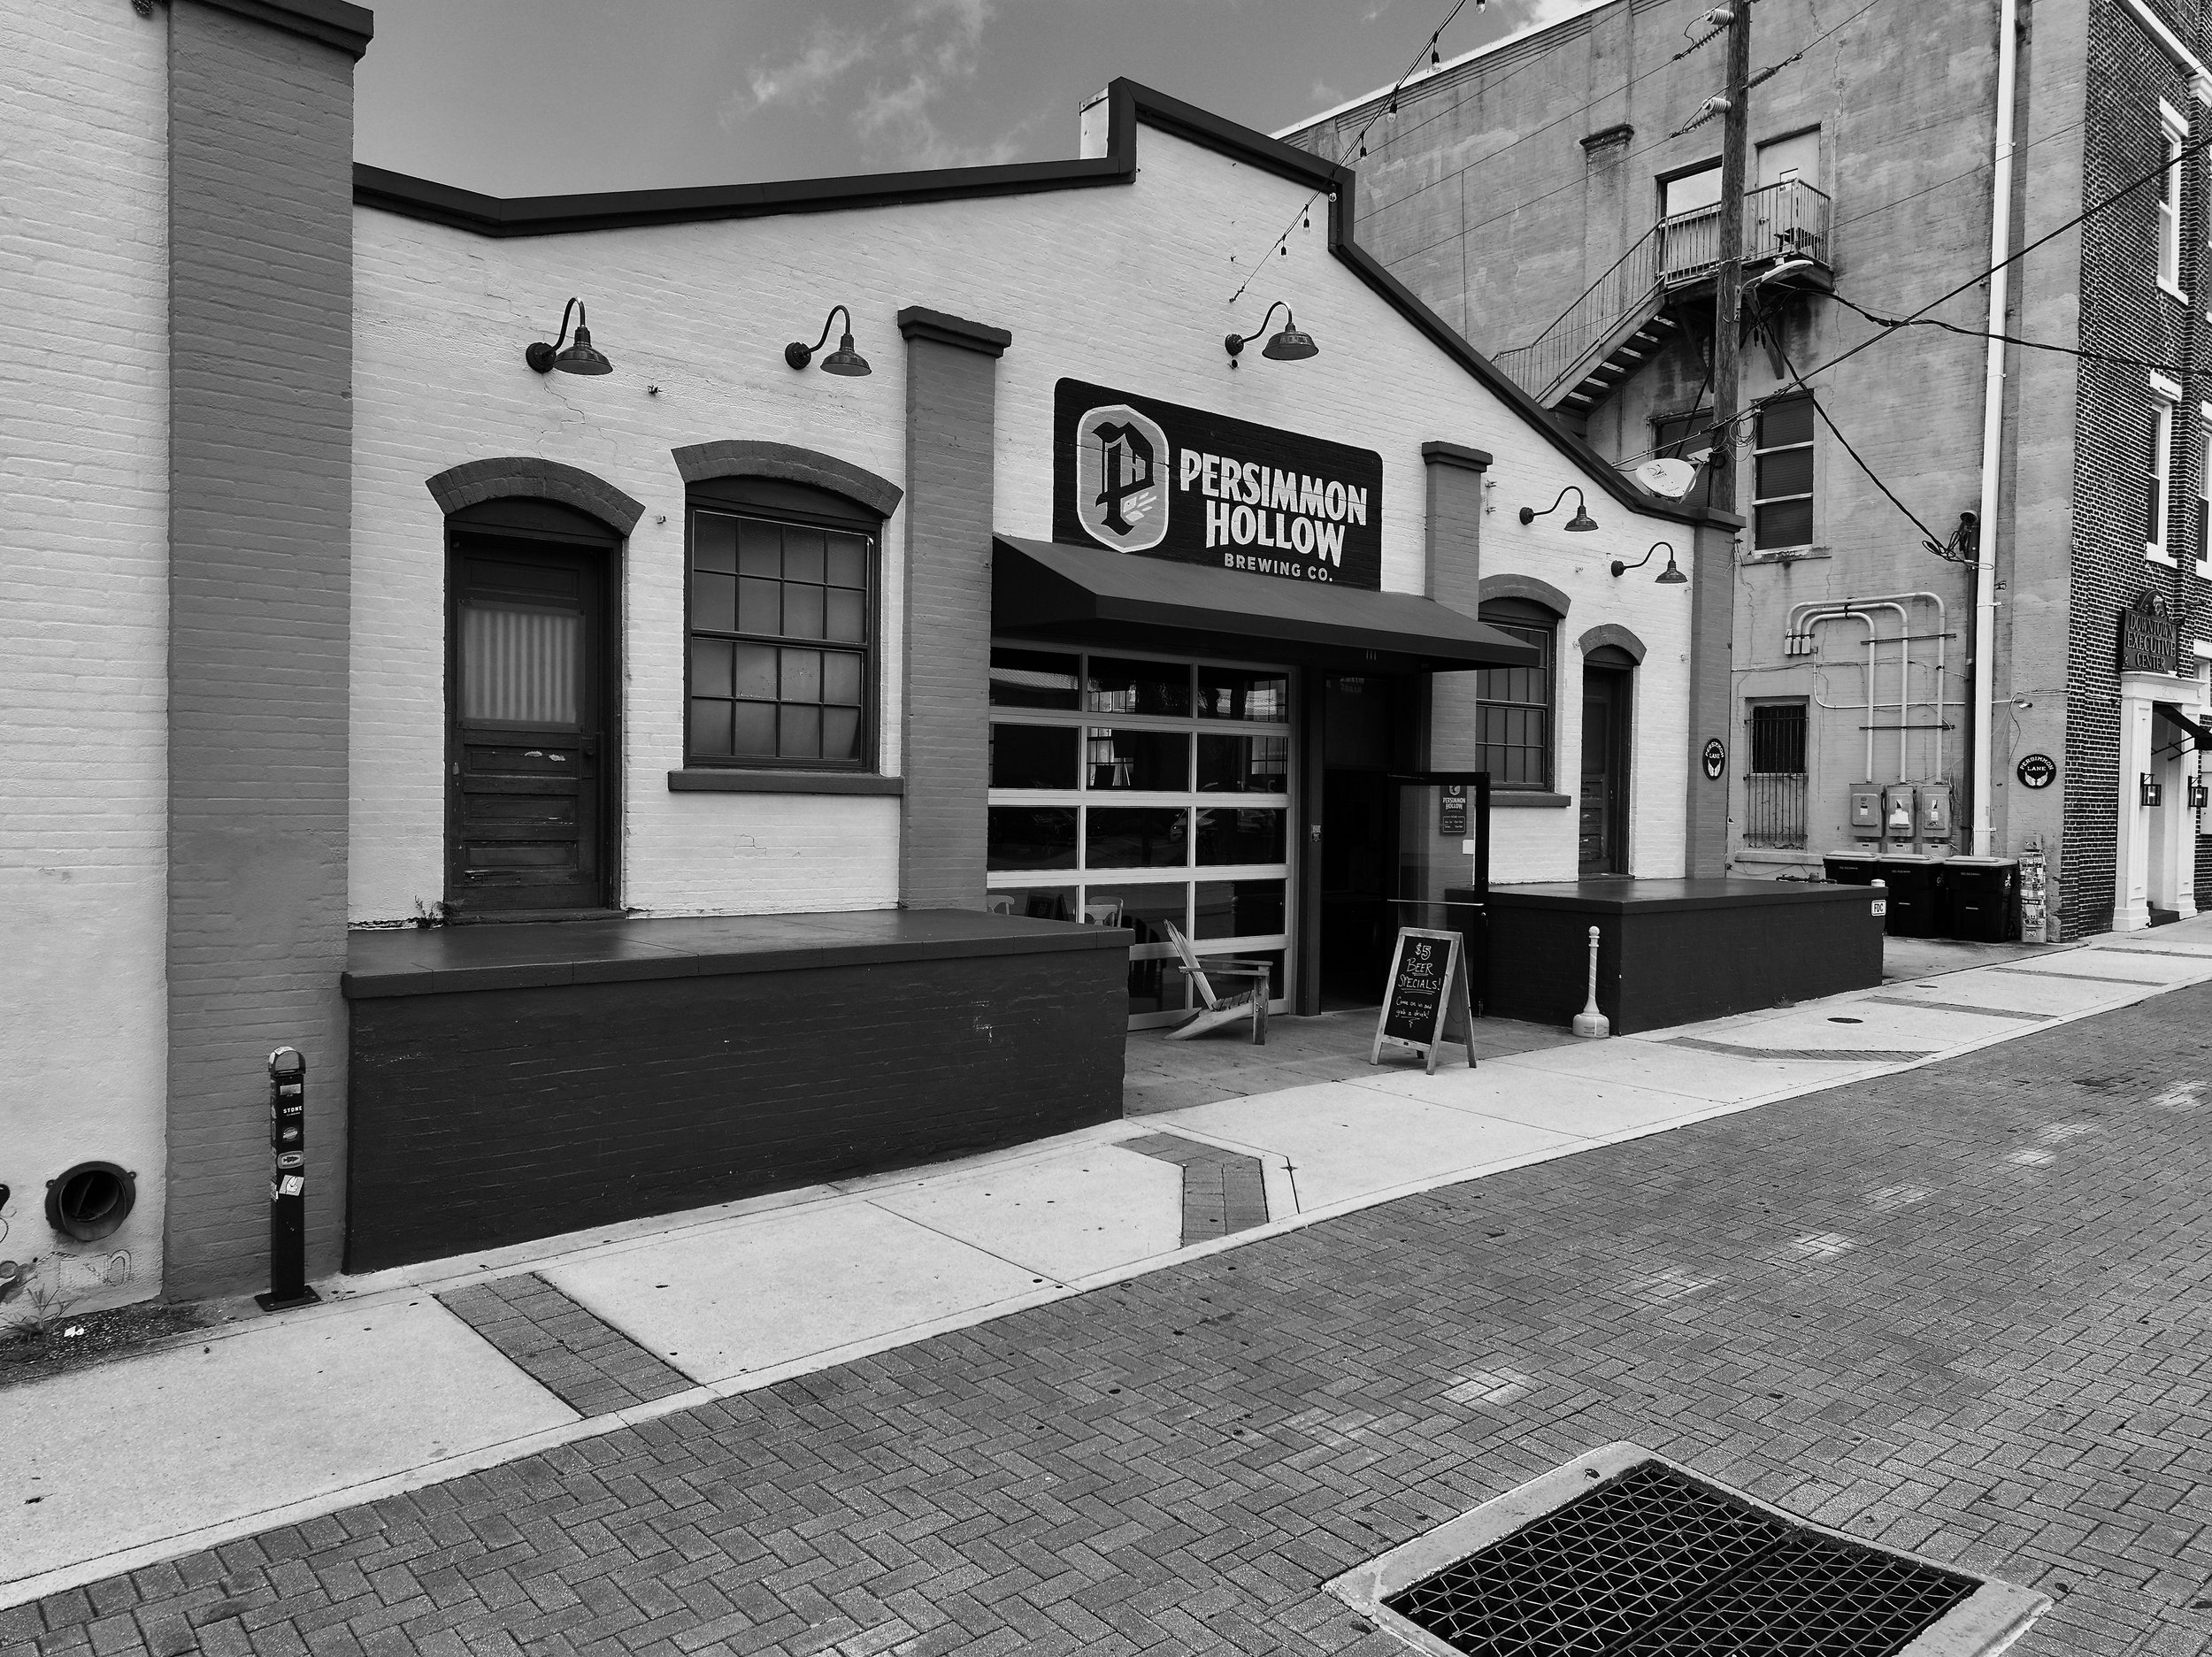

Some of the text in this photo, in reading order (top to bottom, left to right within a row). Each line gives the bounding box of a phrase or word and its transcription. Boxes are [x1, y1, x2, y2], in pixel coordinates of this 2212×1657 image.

[1180, 448, 1367, 525] PERSIMMON
[1206, 499, 1346, 567] HOLLOW
[1225, 552, 1333, 582] BREWING CO.
[2130, 614, 2174, 640] DOWNTOWN
[2127, 631, 2176, 657] EXECUTIVE
[2136, 652, 2167, 671] CENTER
[1705, 741, 1724, 757] PERSIMMON
[2019, 756, 2055, 771] PERSIMMON
[1873, 903, 1884, 913] FDC
[1415, 942, 1432, 961] $5
[1407, 957, 1433, 975] BEER
[1398, 974, 1440, 990] SPECIALS!
